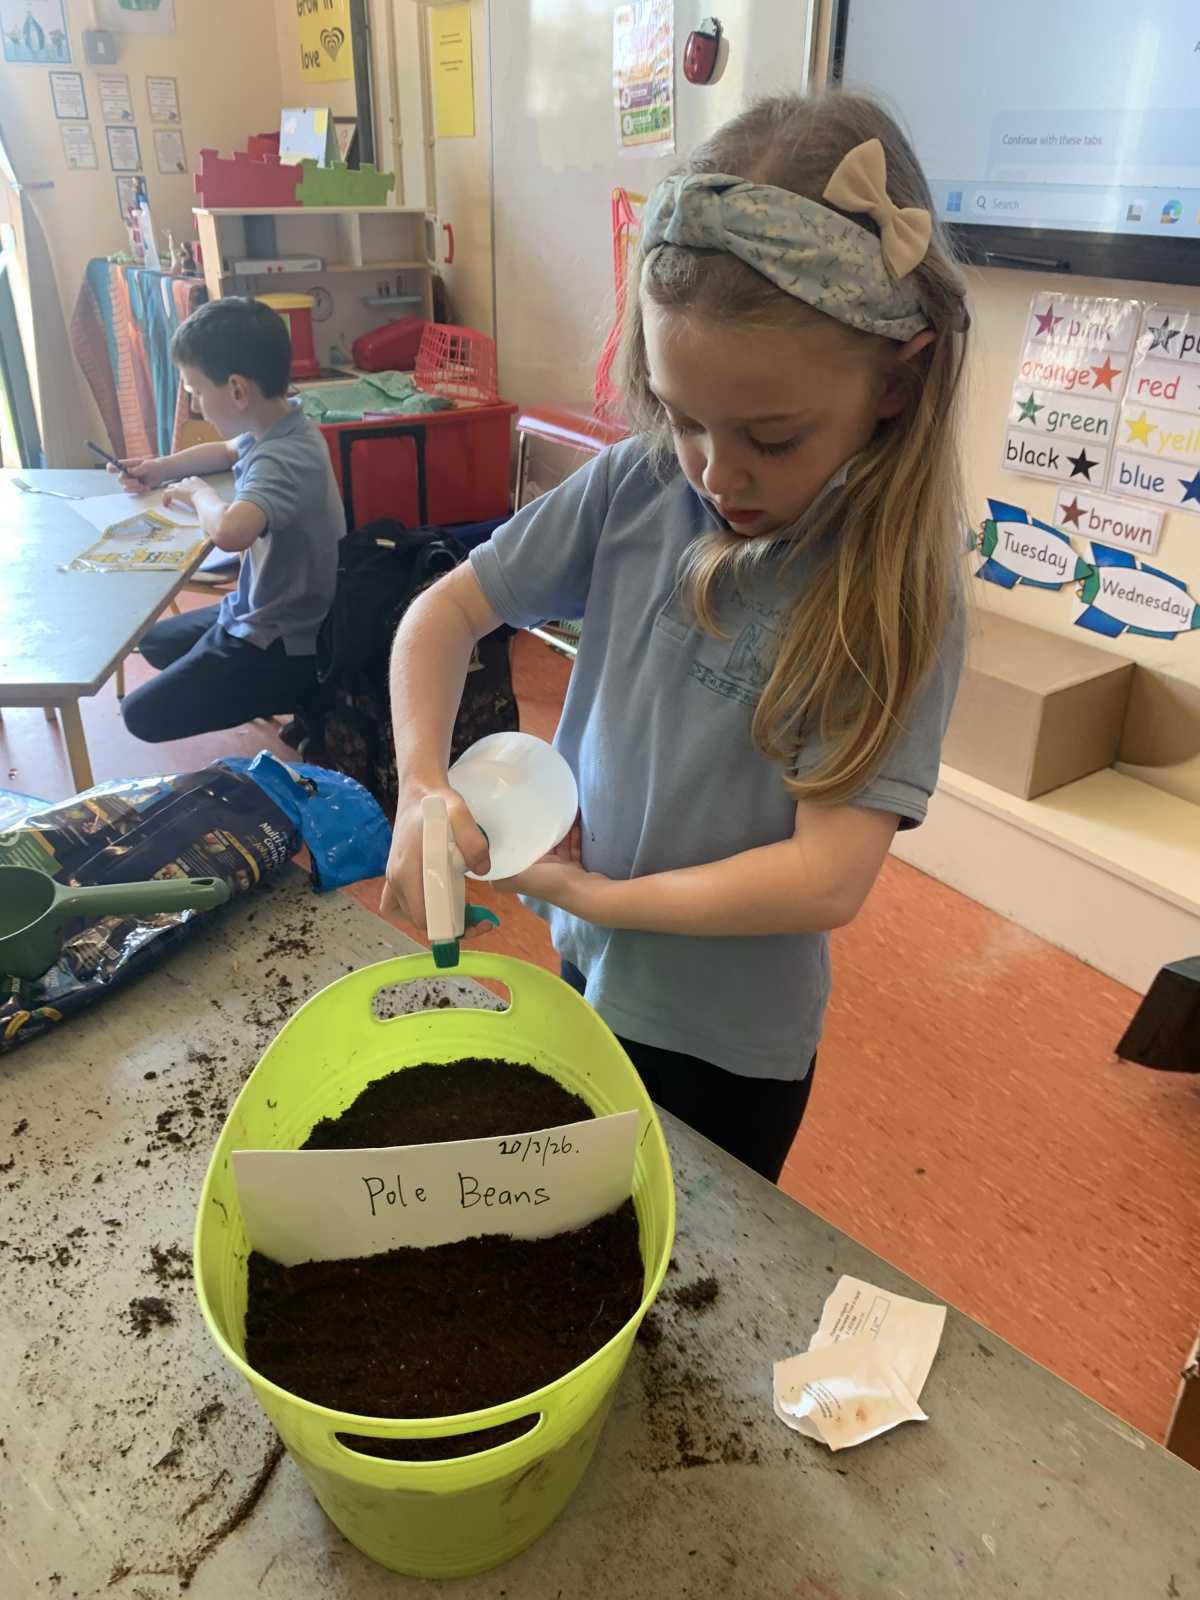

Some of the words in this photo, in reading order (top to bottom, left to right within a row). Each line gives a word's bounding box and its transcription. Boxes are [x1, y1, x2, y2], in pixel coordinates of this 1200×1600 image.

[300, 44, 321, 70] love
[1001, 133, 1038, 145] Continue
[1040, 133, 1057, 145] with
[1059, 133, 1082, 145] these
[1083, 134, 1102, 145] tabs
[993, 197, 1020, 209] Search
[1067, 315, 1113, 344] pink
[1021, 360, 1091, 390] orange
[1137, 375, 1181, 400] red
[1046, 410, 1109, 436] green
[1006, 439, 1060, 470] black
[1119, 461, 1166, 493] blue
[1088, 507, 1153, 545] brown
[1003, 531, 1068, 576] Tuesday
[1102, 577, 1191, 625] Wednesday
[362, 1174, 427, 1216] Pole
[458, 1172, 551, 1210] Beans
